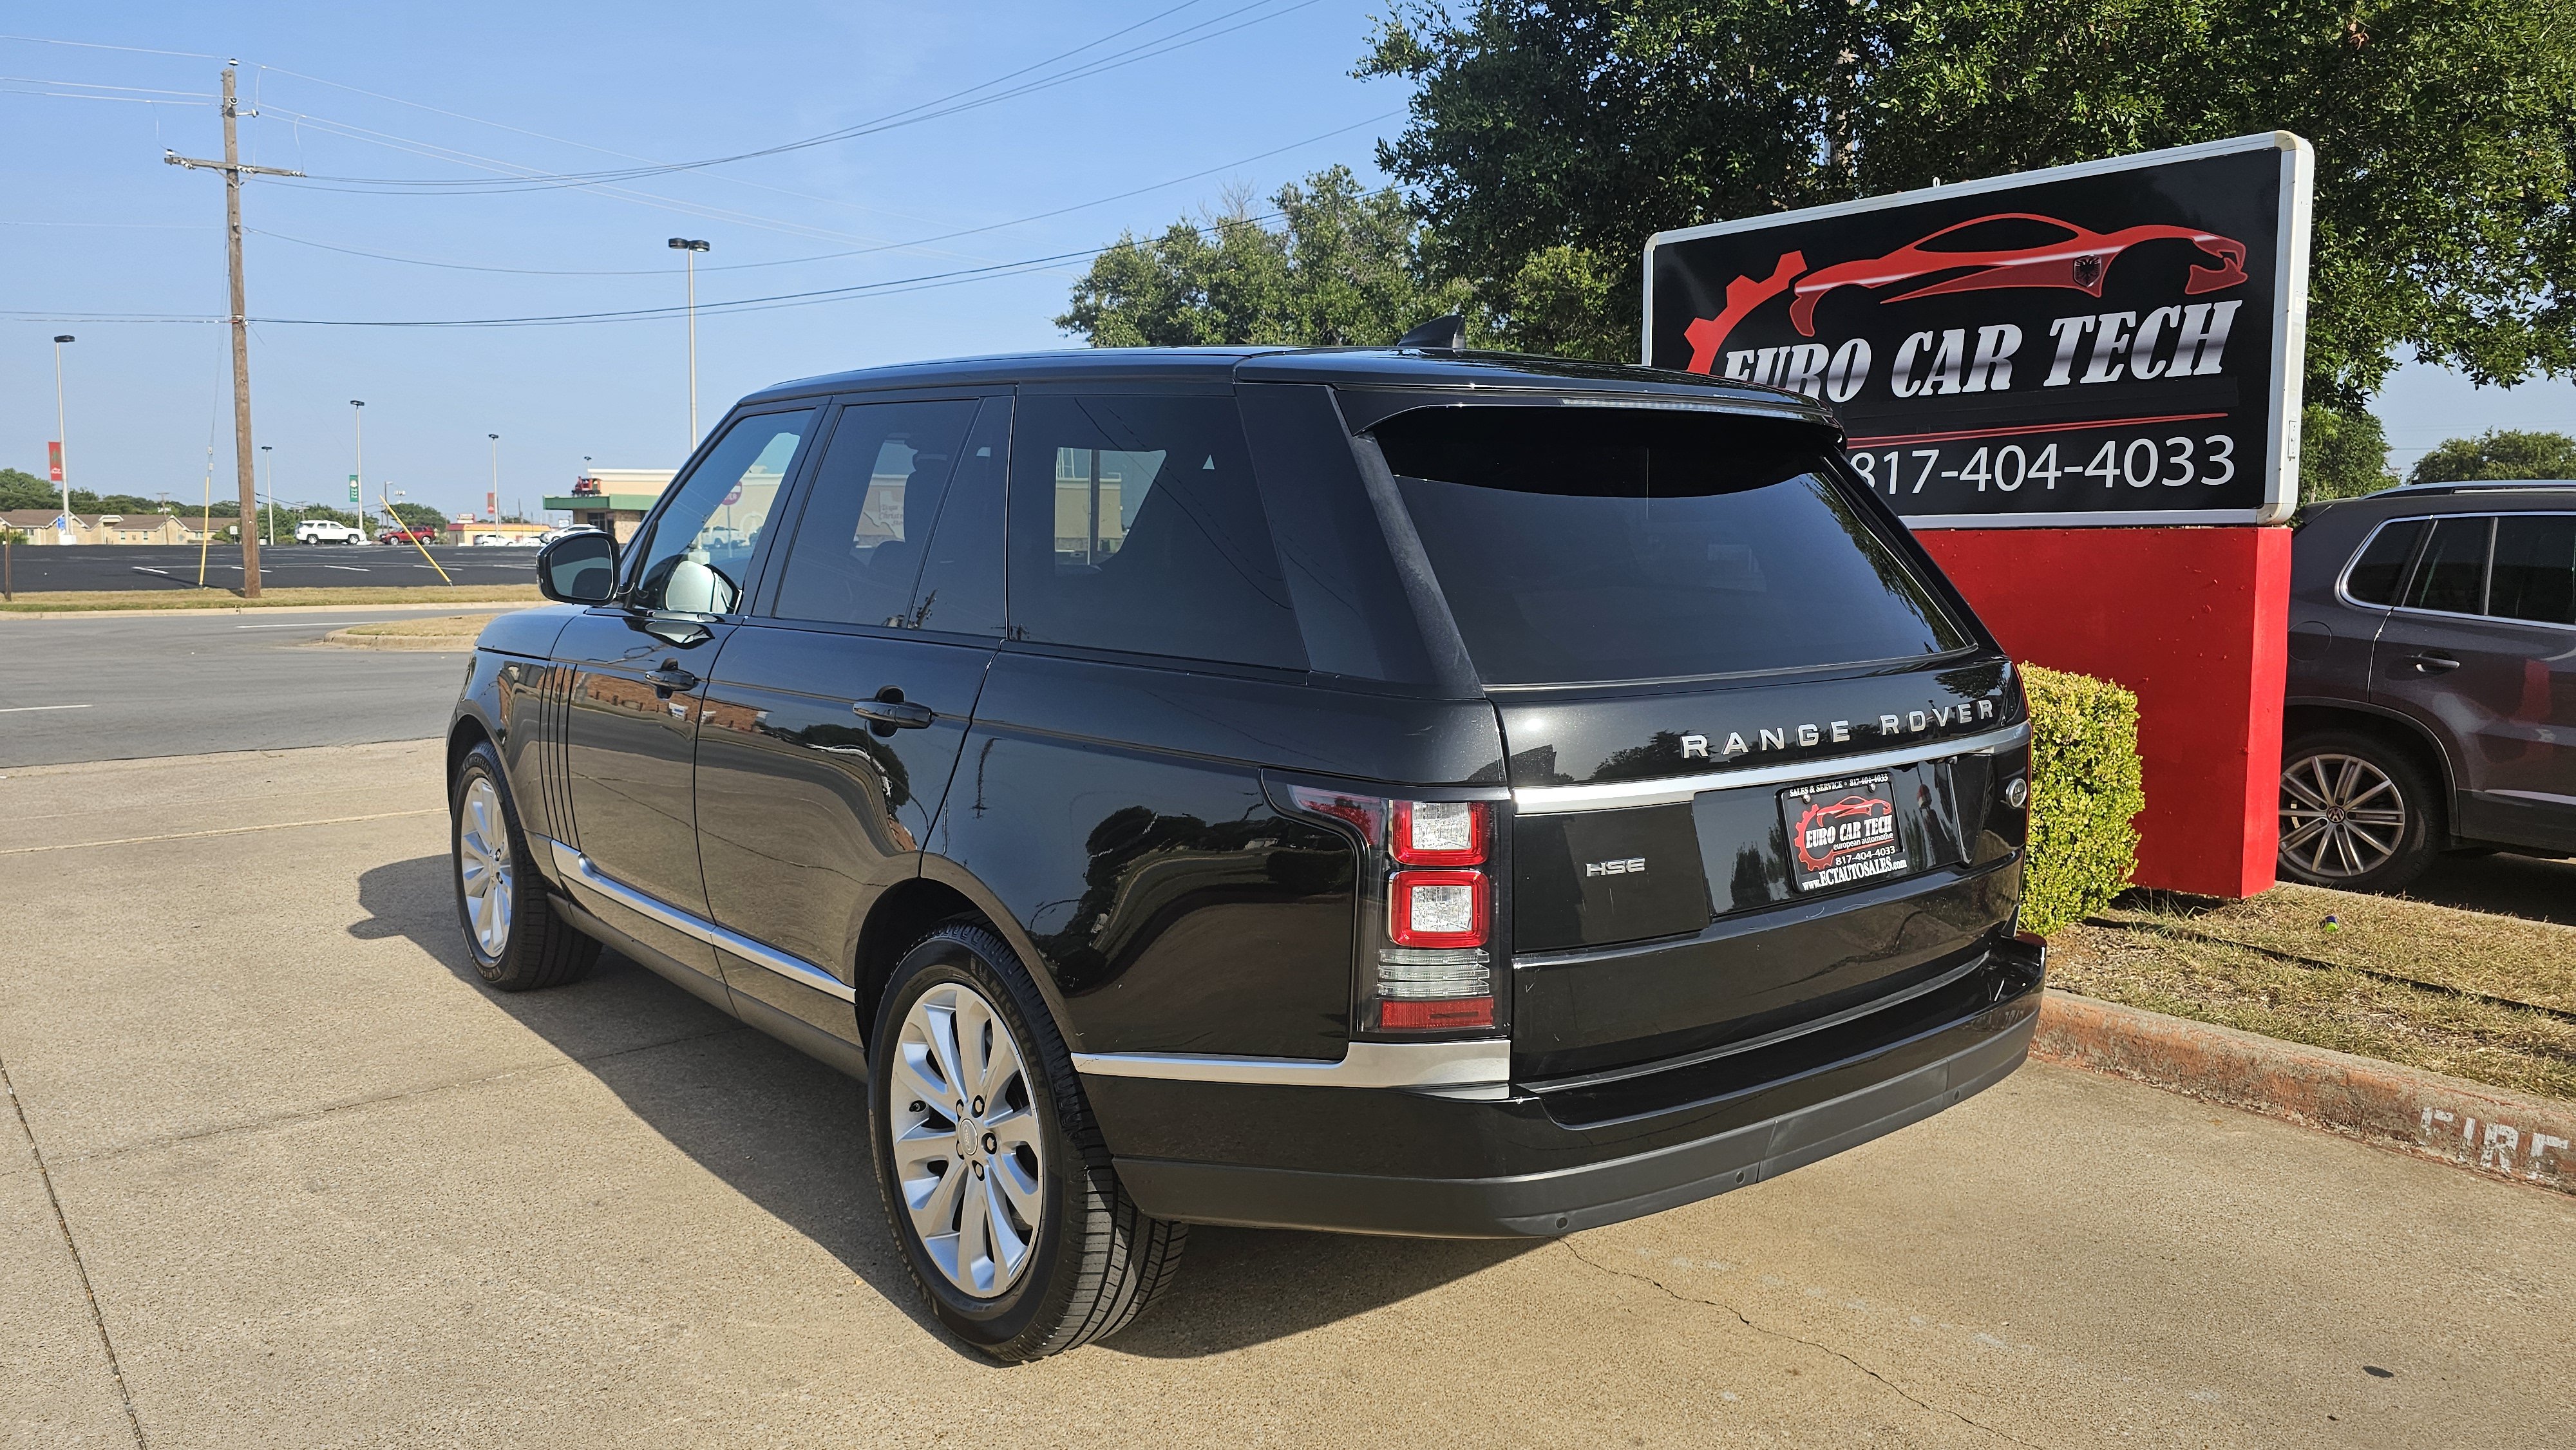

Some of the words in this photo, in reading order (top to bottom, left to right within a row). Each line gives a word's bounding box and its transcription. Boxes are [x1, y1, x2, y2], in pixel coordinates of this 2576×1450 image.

[1891, 323, 2023, 398] CAR
[2043, 299, 2243, 387] TECH
[1850, 435, 2235, 494] 817-404-4033
[1681, 720, 1850, 759] RANGE
[1879, 700, 1993, 736] ROVER
[1789, 786, 1809, 797] SALES
[1815, 780, 1842, 793] SERVICE
[1849, 773, 1889, 787] 817-404-4033
[1805, 825, 1836, 849] EURO
[1839, 821, 1861, 842] CAR
[1864, 814, 1893, 836] TECH
[1833, 840, 1861, 851] european
[1861, 832, 1894, 845] automotive
[1586, 857, 1645, 877] HSE
[1835, 845, 1896, 866] 817-404-4033
[1801, 856, 1908, 891] www.ECTAUTOSALES.com
